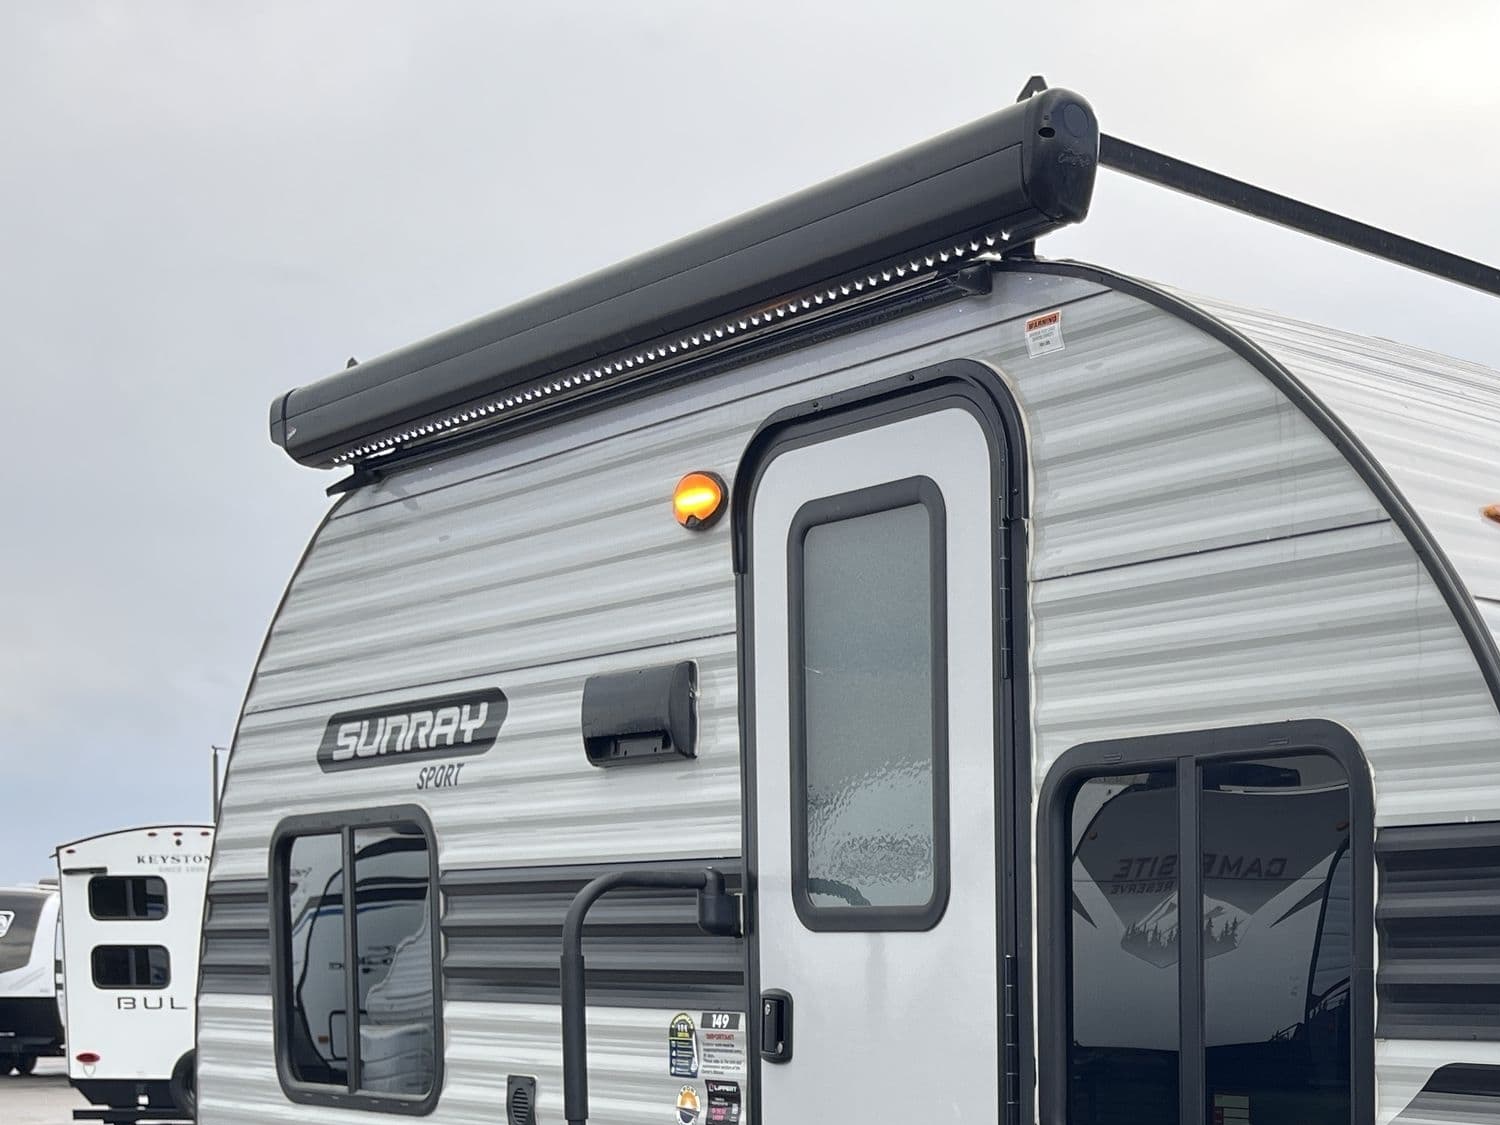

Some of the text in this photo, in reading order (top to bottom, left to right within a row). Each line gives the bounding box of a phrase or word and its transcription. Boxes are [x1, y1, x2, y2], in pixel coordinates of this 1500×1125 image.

[332, 702, 489, 761] SUNRAY
[417, 763, 465, 790] SPORT
[117, 997, 188, 1010] BUL
[712, 1014, 730, 1029] 149
